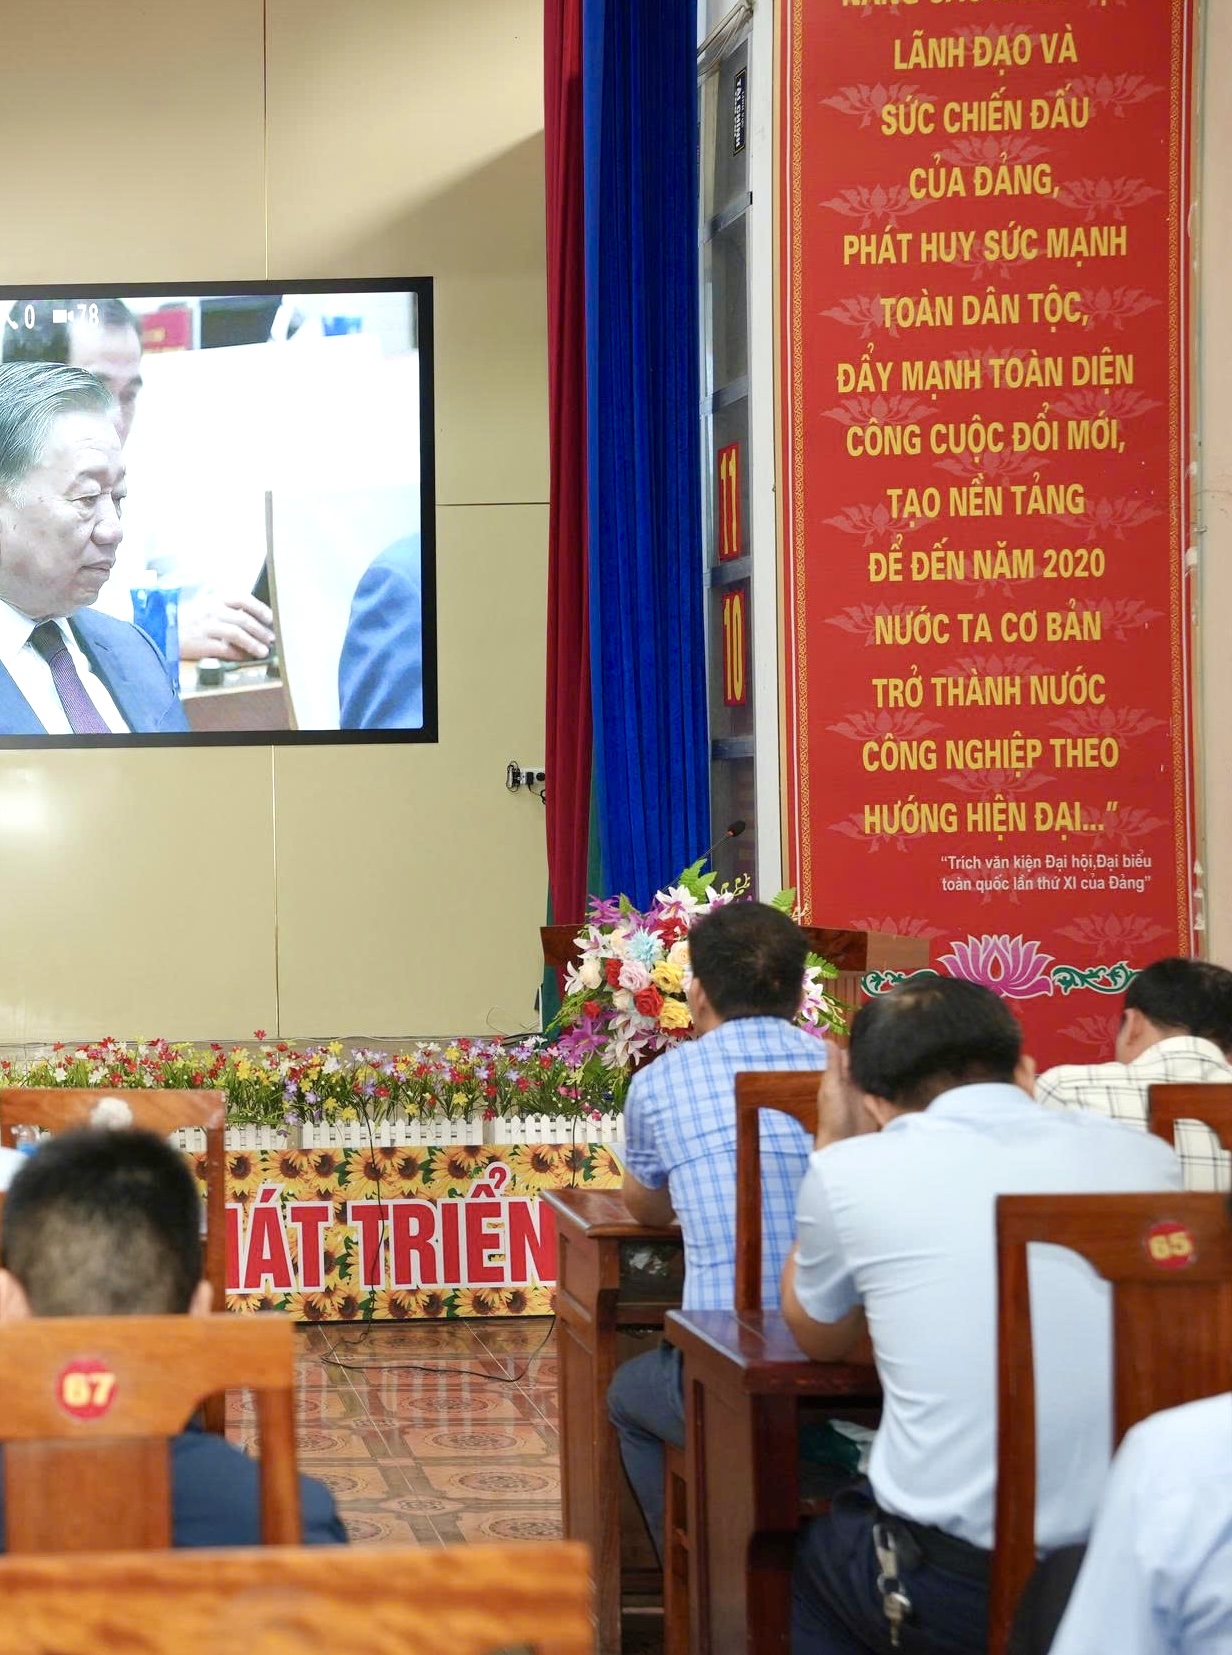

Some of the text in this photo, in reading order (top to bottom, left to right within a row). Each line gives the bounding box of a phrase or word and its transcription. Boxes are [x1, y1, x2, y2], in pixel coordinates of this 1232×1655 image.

[894, 24, 1078, 76] LÃNH ĐẠO VÀ
[881, 83, 1089, 136] SỨC CHIẾN ĐẤU
[909, 152, 1059, 200] CỦA ĐẢNG,
[843, 220, 1127, 267] PHÁT HUY SỨC MẠNH
[24, 304, 35, 329] 0
[77, 303, 99, 327] 78
[879, 284, 1088, 332] TOÀN DÂN TỘC,
[836, 342, 1133, 399] ĐẨY MẠNH TOÀN DIỆN
[846, 402, 1125, 463] CÔNG CUỘC ĐỔI MỚI,
[720, 449, 737, 554] 11
[886, 472, 1085, 527] TẠO NỀN TẢNG
[867, 533, 1105, 582] ĐỂ ĐẾN NĂM 2020
[874, 598, 1101, 646] NƯỚC TA CƠ BẢN
[723, 595, 742, 701] 10
[871, 665, 1106, 708] TRỞ THÀNH NƯỚC
[862, 730, 1119, 778] CÔNG NGHIỆP THEO
[864, 793, 958, 835] HƯỚNG
[967, 793, 1026, 841] HIỆN
[942, 877, 972, 891] toàn
[976, 874, 1009, 894] quốc
[1014, 874, 1033, 890] lần
[1037, 876, 1061, 890] thứ
[1063, 876, 1077, 890] XI
[1080, 873, 1105, 890] của
[985, 857, 1009, 869] văn
[1014, 855, 1042, 872] kiện
[1045, 854, 1067, 872] Đại
[1123, 849, 1152, 868] biểu
[347, 1162, 555, 1291] TRIỂN
